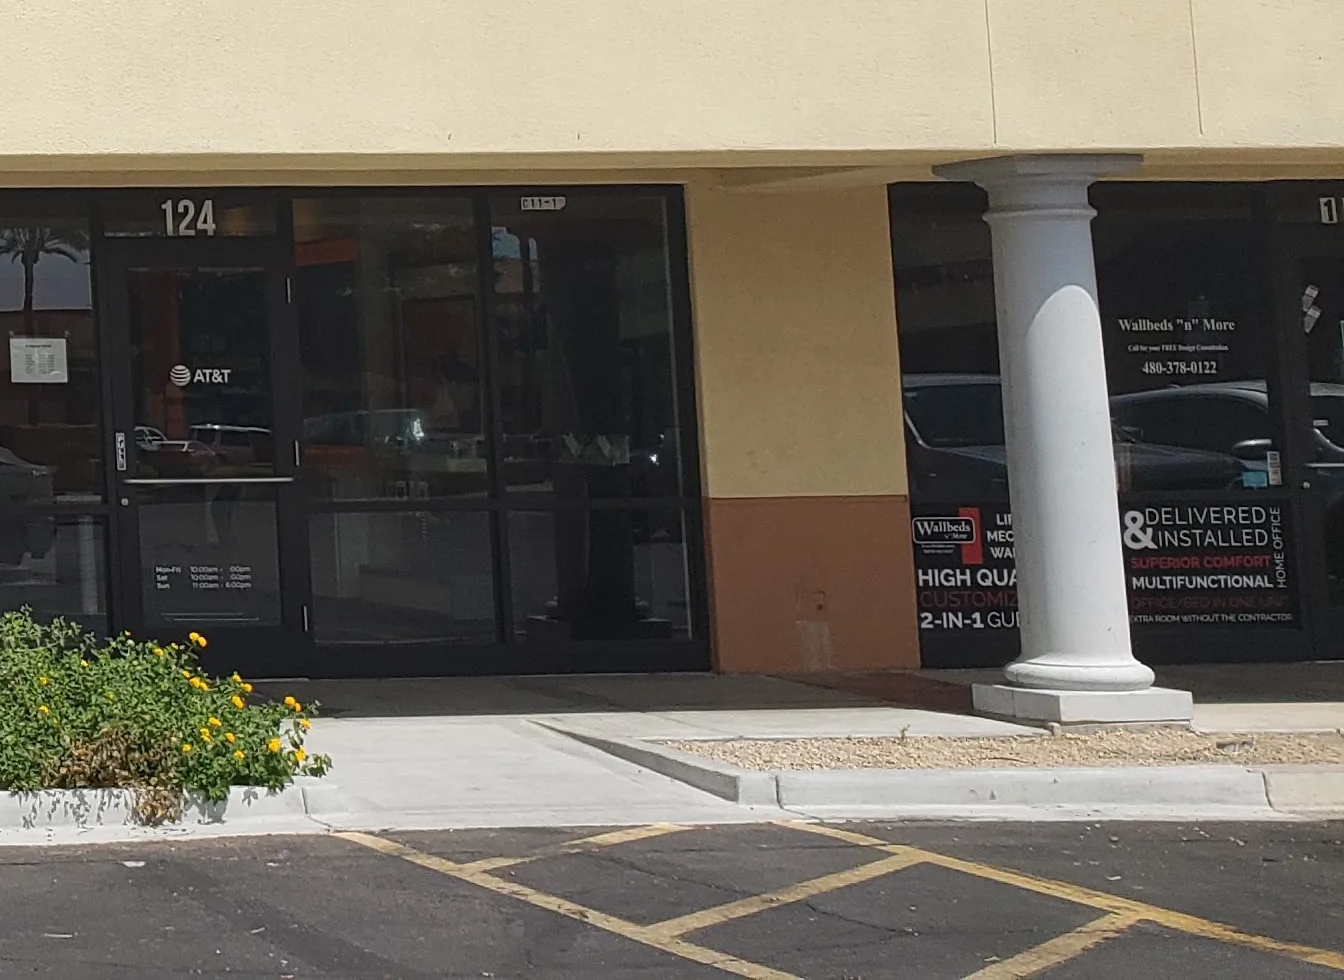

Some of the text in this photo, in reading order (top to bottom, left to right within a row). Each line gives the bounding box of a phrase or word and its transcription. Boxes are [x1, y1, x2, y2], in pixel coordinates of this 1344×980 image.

[161, 199, 217, 237] 124
[1118, 318, 1174, 331] Wallbeds
[1202, 318, 1236, 331] More
[1142, 361, 1217, 374] 480-378-0122
[193, 368, 232, 384] AT&T
[1145, 506, 1267, 525] DELIVERED
[915, 520, 971, 536] Wallbeds
[1123, 510, 1159, 550] &
[1158, 528, 1269, 547] INSTALLED
[1269, 507, 1288, 588] HOME OFFICE
[1130, 555, 1272, 569] SUPERIOR COMFORT
[917, 568, 972, 587] HIGH
[1132, 574, 1274, 590] MULTIFUNCTIONAL
[920, 611, 985, 628] 2-IN-1
[1180, 614, 1221, 622] WITHOUT
[1221, 613, 1237, 622] THE
[1237, 612, 1293, 622] CONTRACTOR
